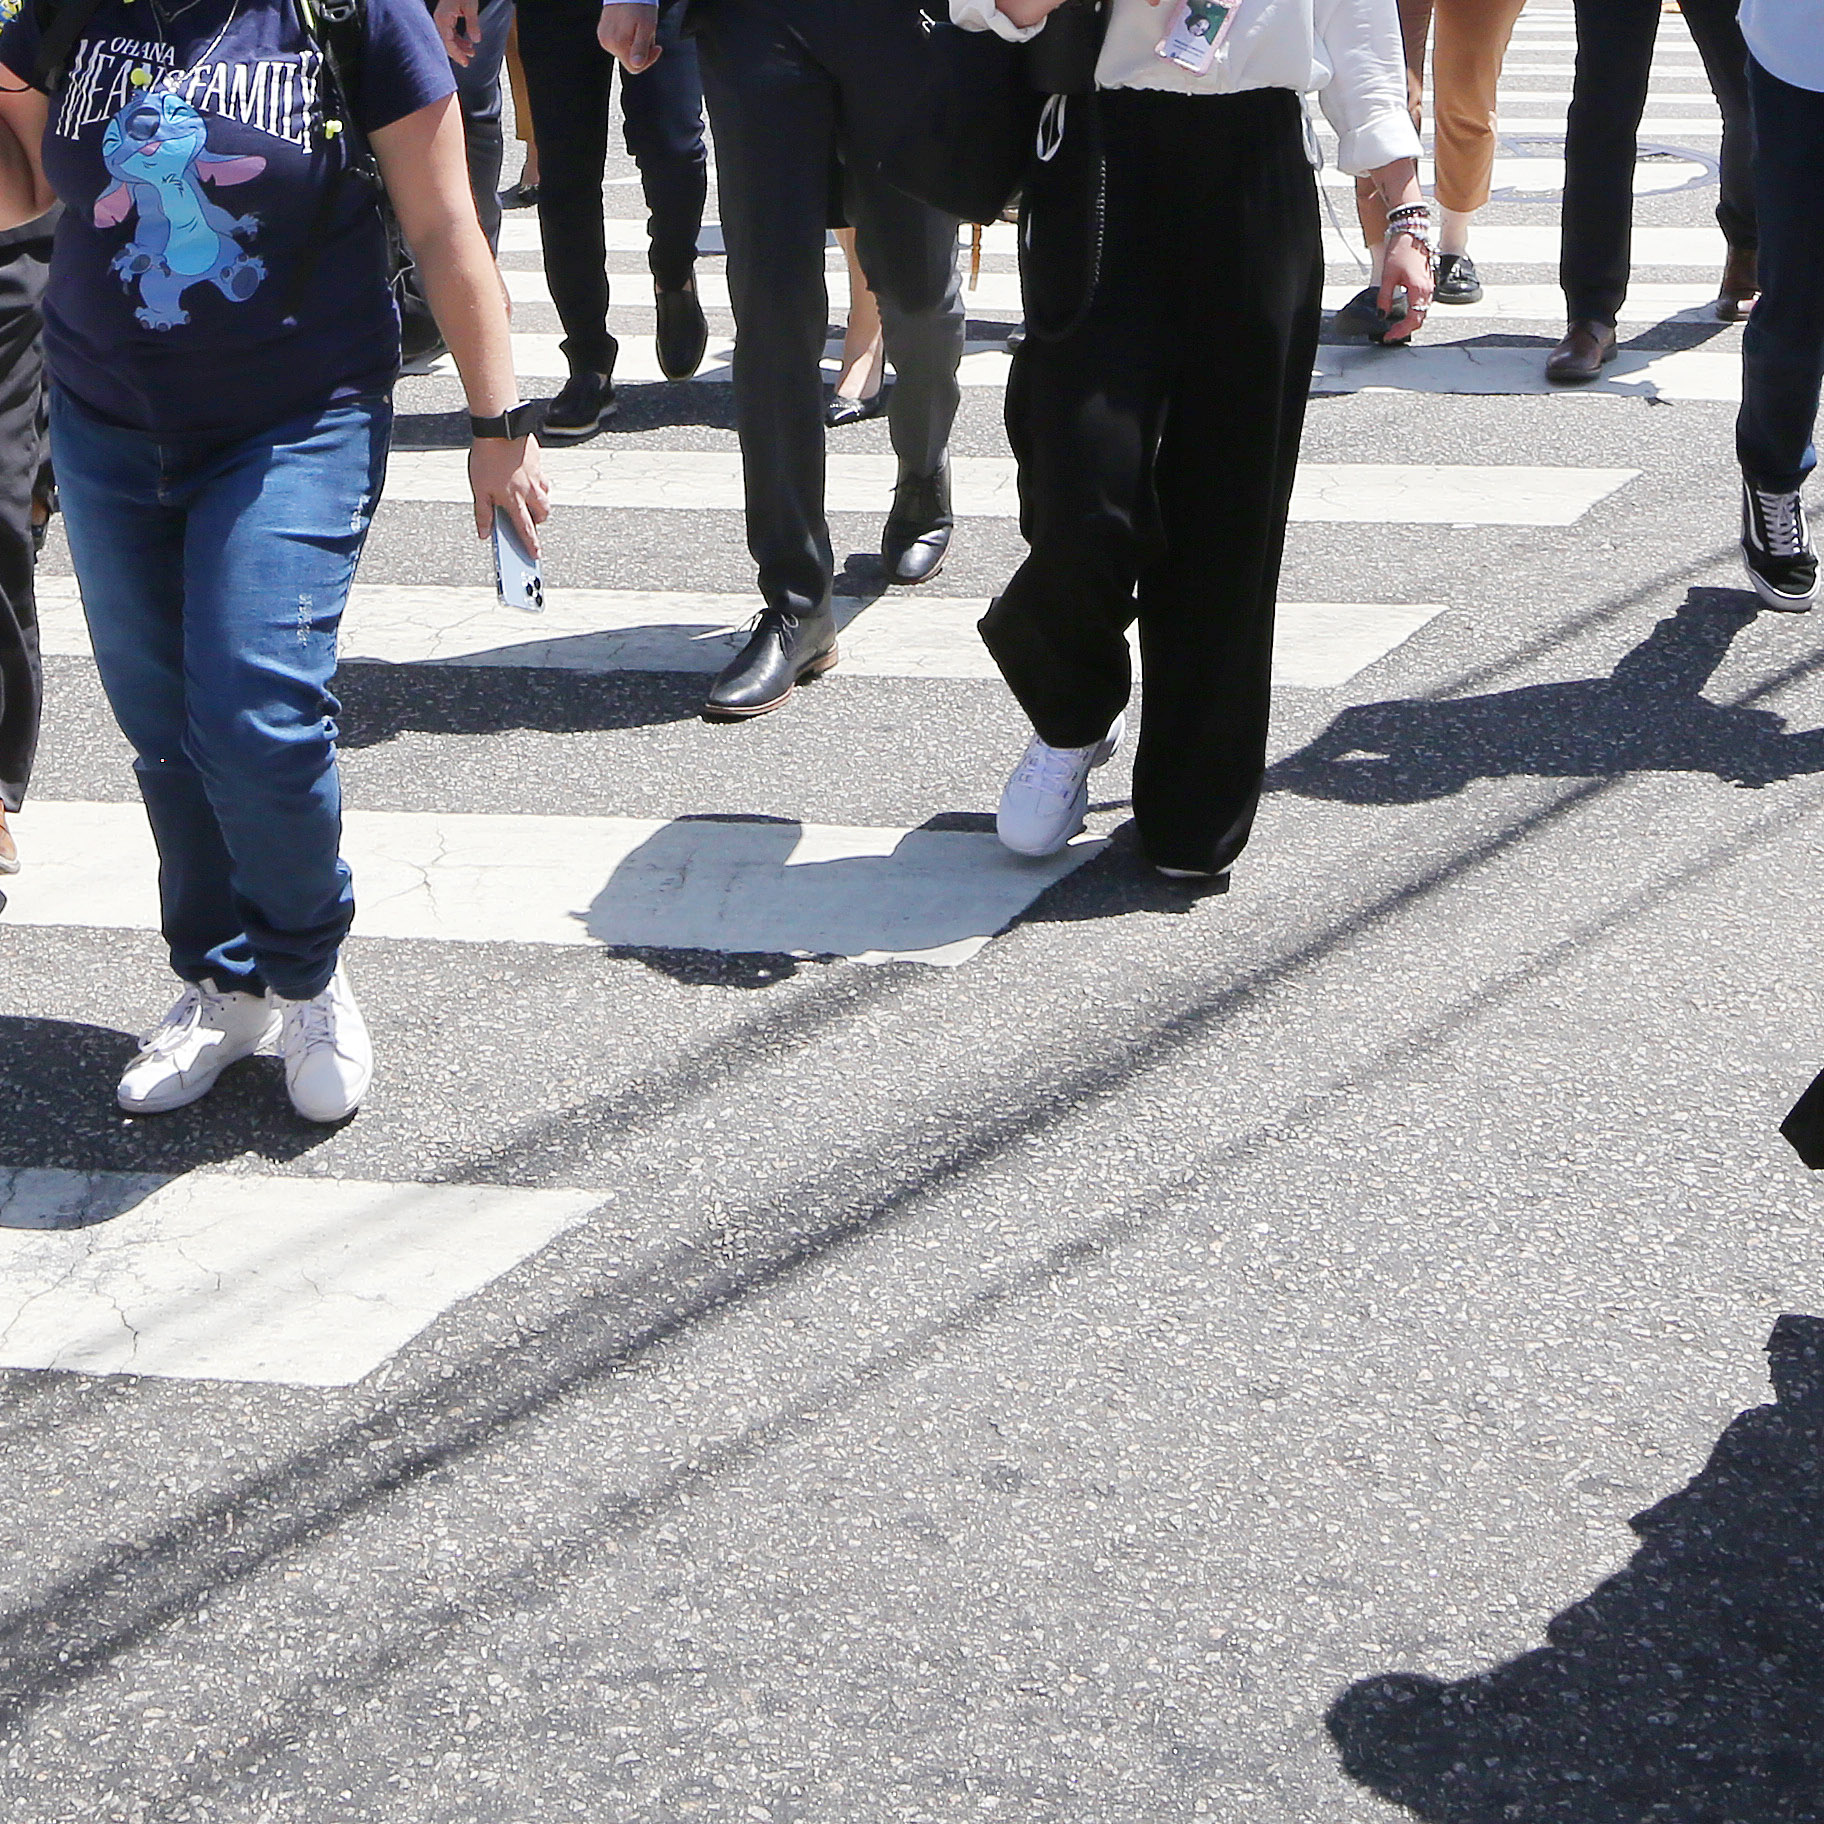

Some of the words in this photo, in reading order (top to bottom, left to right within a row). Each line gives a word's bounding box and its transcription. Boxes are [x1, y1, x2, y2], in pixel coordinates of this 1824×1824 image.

[110, 36, 175, 67] OHANA
[55, 38, 184, 141] MEAN
[184, 49, 324, 155] FAMILY
